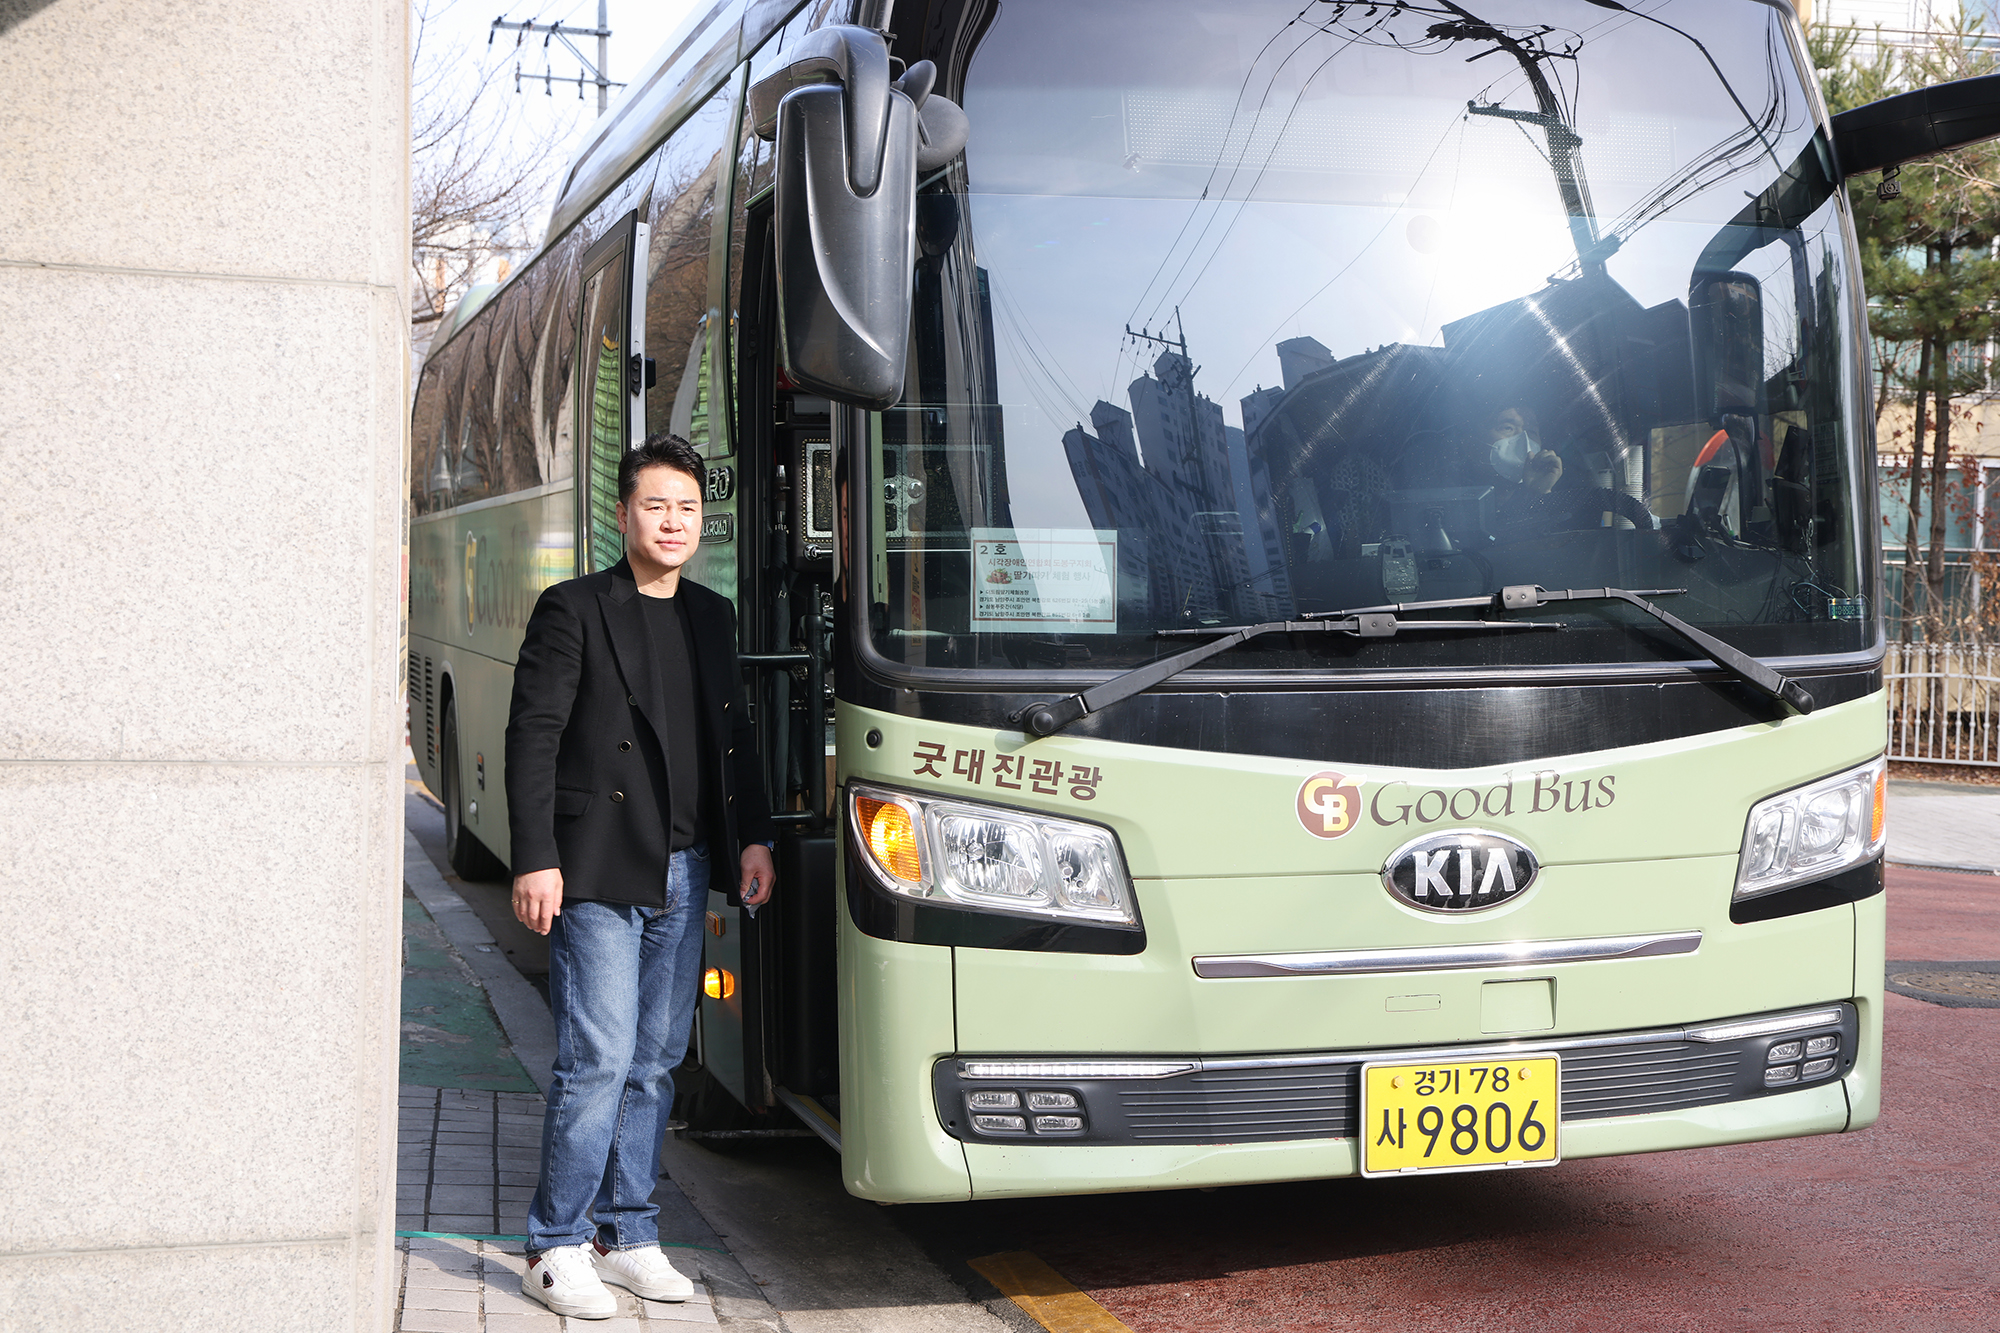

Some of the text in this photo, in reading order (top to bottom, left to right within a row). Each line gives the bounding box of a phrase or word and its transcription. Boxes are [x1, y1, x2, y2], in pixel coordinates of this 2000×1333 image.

[980, 543, 1007, 556] 2 호
[913, 741, 1103, 801] 굿대진관광
[1370, 769, 1616, 827] Good Bus
[1412, 847, 1517, 897] KIA
